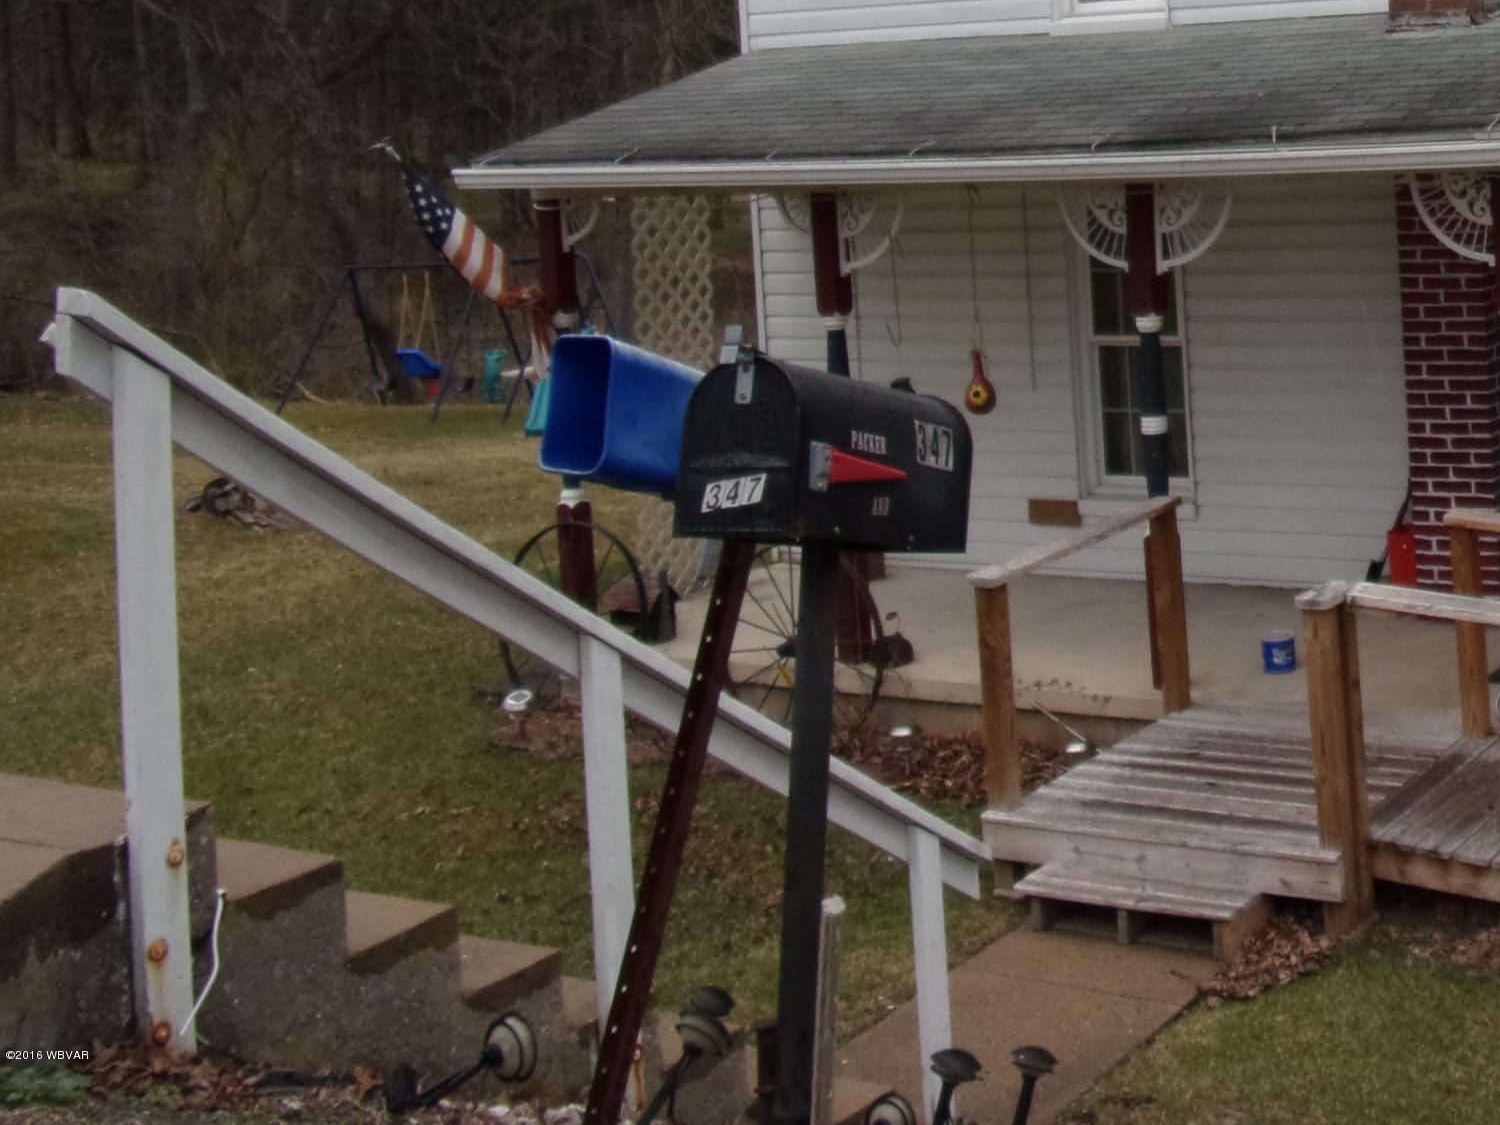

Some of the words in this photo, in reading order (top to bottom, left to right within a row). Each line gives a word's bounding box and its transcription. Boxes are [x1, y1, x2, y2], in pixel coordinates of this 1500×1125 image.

[851, 430, 887, 454] PACKER
[917, 423, 951, 468] 347
[706, 476, 762, 509] 347
